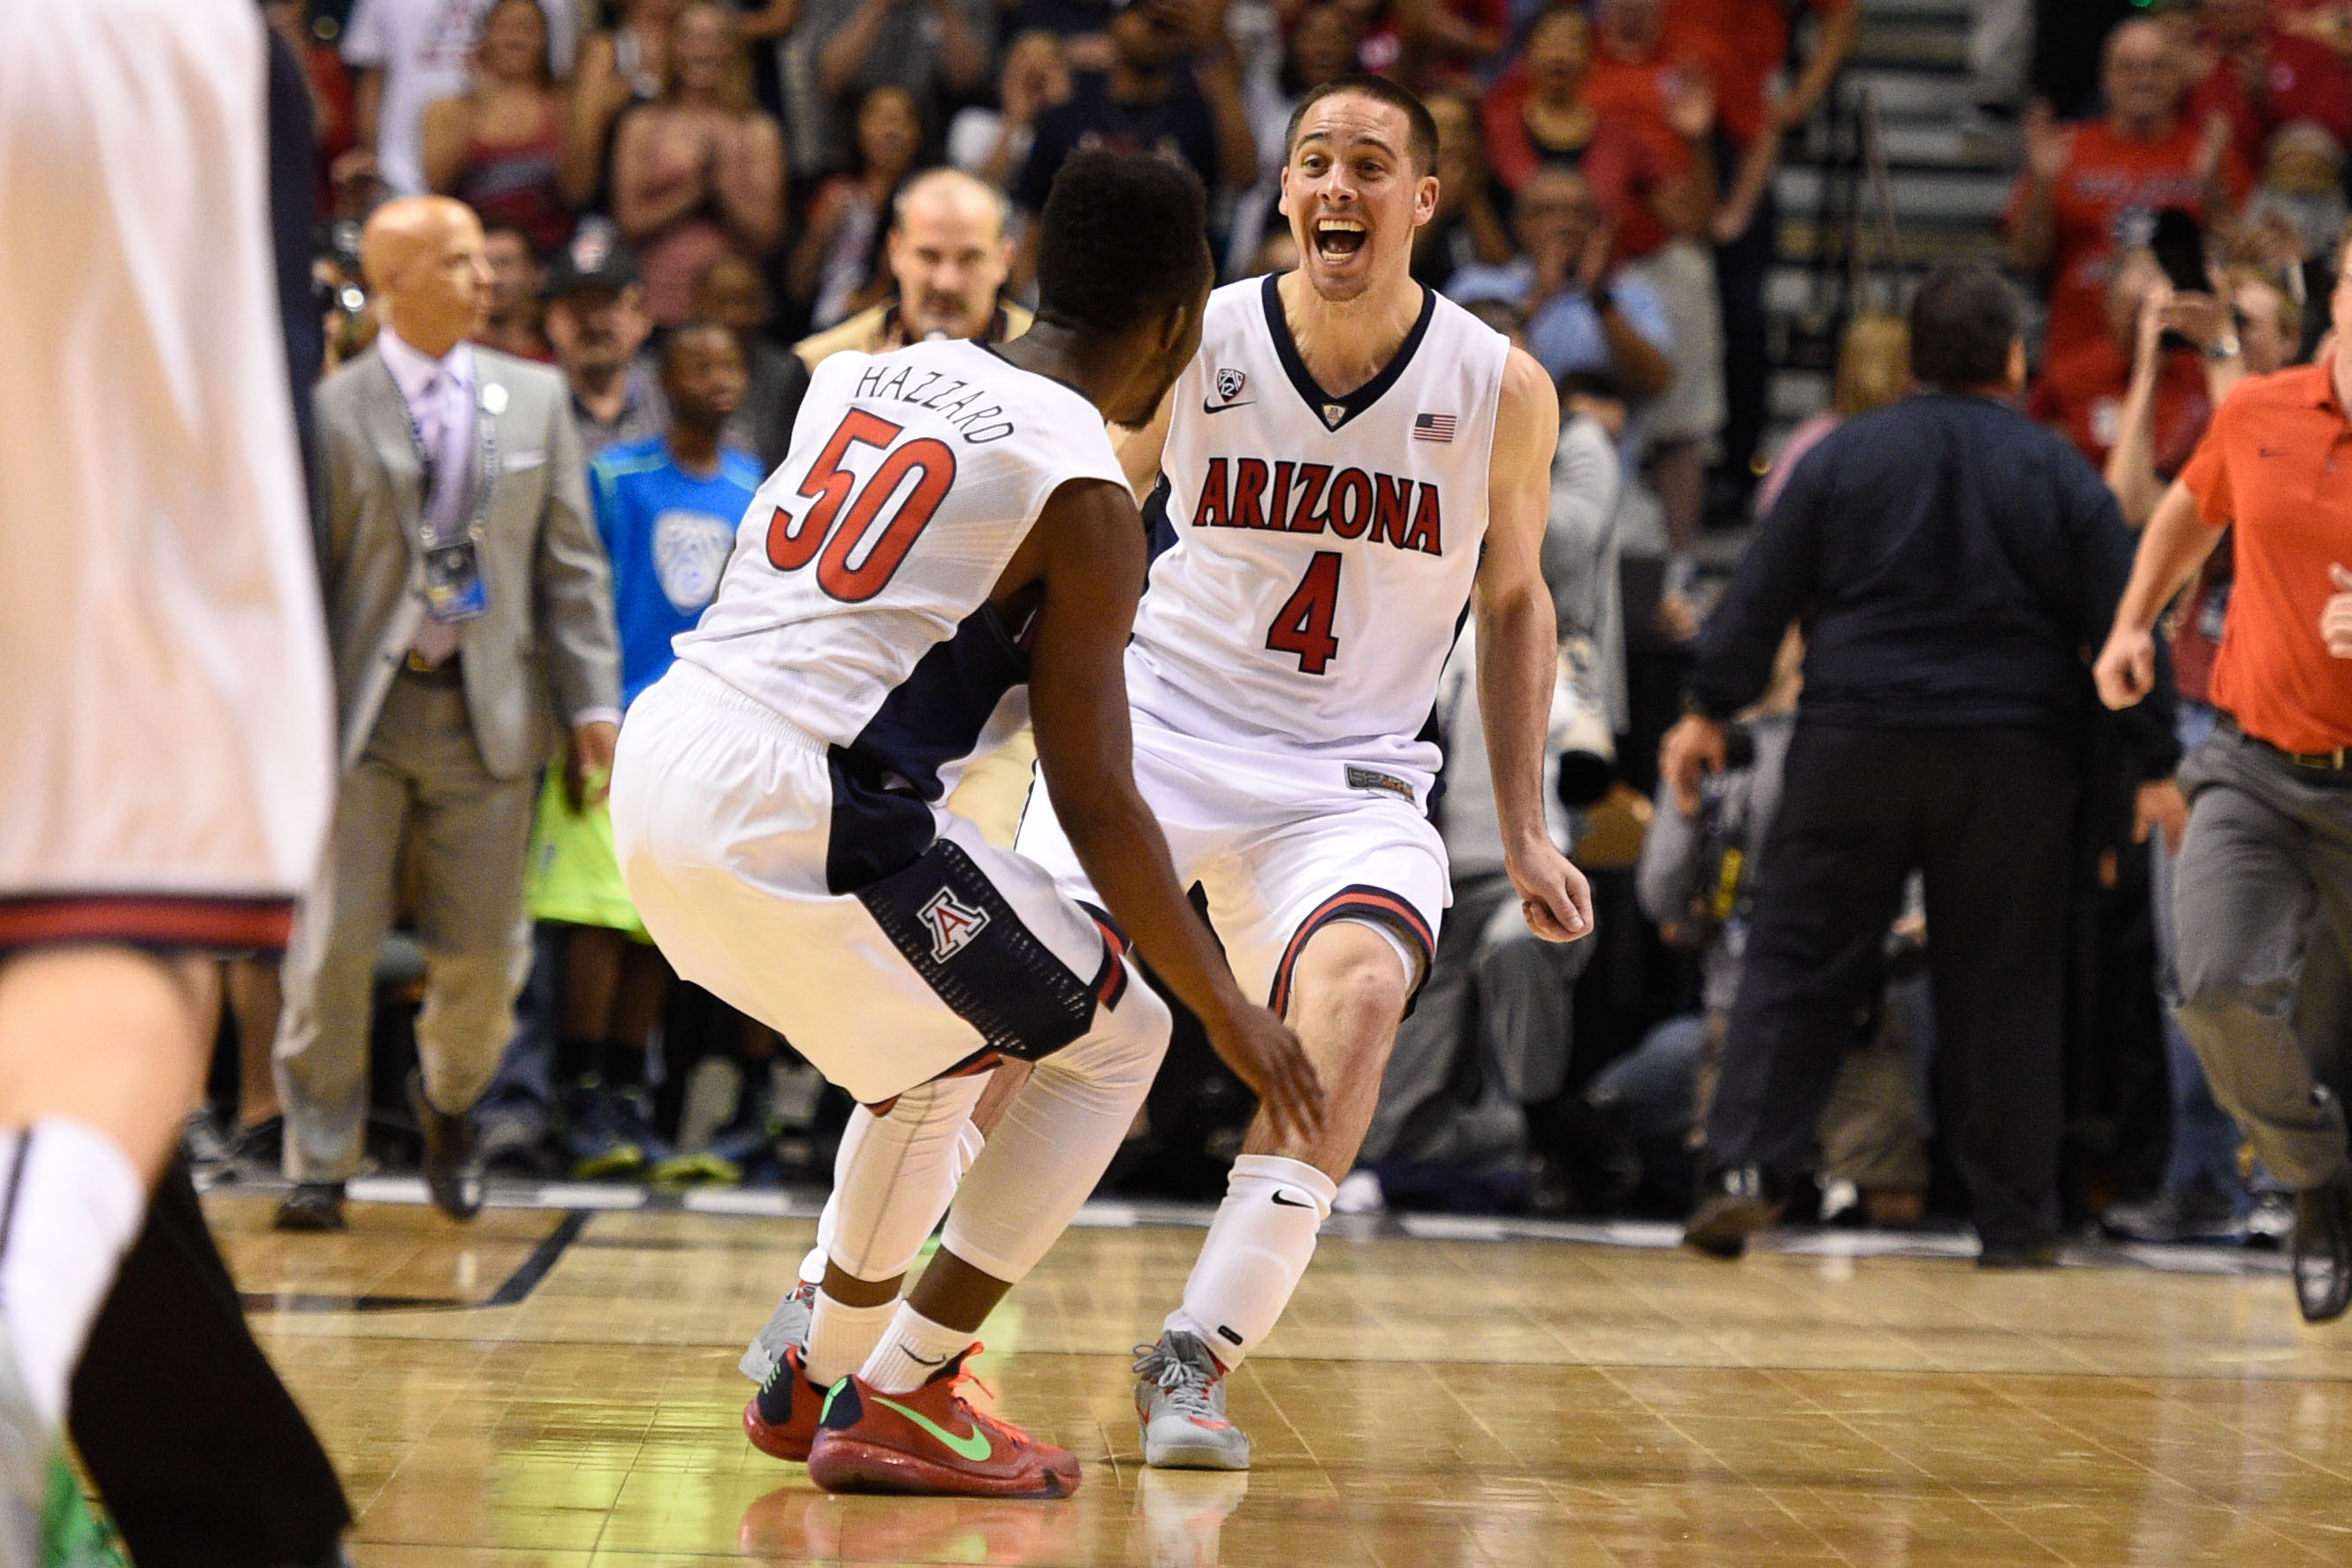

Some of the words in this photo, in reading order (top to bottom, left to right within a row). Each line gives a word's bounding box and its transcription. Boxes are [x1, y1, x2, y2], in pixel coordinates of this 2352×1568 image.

[855, 366, 1014, 444] HAZZARD
[1221, 382, 1236, 397] 12
[765, 407, 956, 603] 50
[1192, 458, 1442, 557] ARIZONA
[1266, 551, 1342, 675] 4
[916, 886, 991, 964] A
